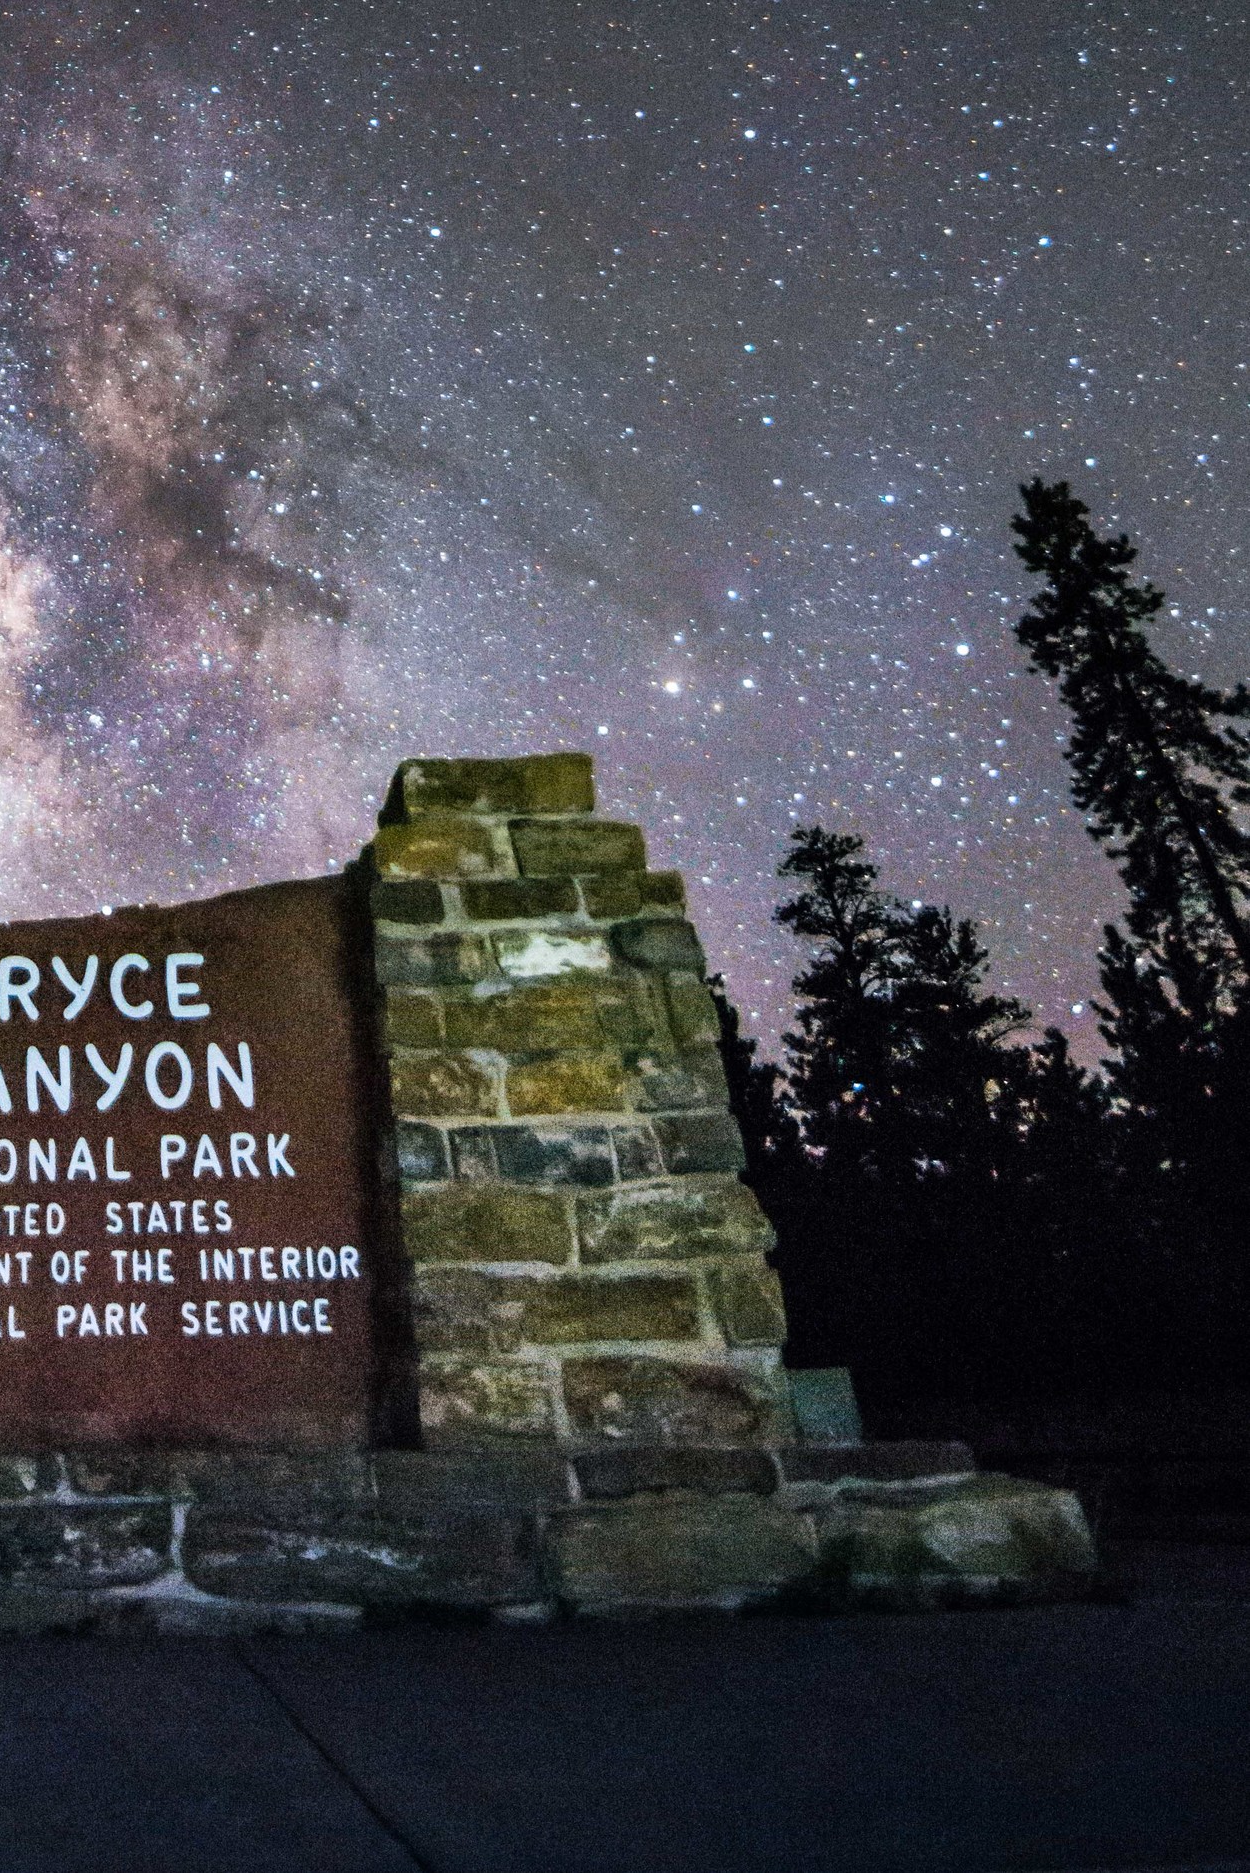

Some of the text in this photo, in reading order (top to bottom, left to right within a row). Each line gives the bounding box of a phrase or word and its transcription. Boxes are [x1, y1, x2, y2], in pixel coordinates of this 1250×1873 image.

[160, 1131, 296, 1179] PARK
[105, 1199, 233, 1234] STATES
[50, 1250, 90, 1284] OF
[111, 1248, 175, 1283] THE
[199, 1246, 359, 1281] INTERIOR
[56, 1302, 148, 1337] PARK
[181, 1298, 332, 1336] SERVICE
